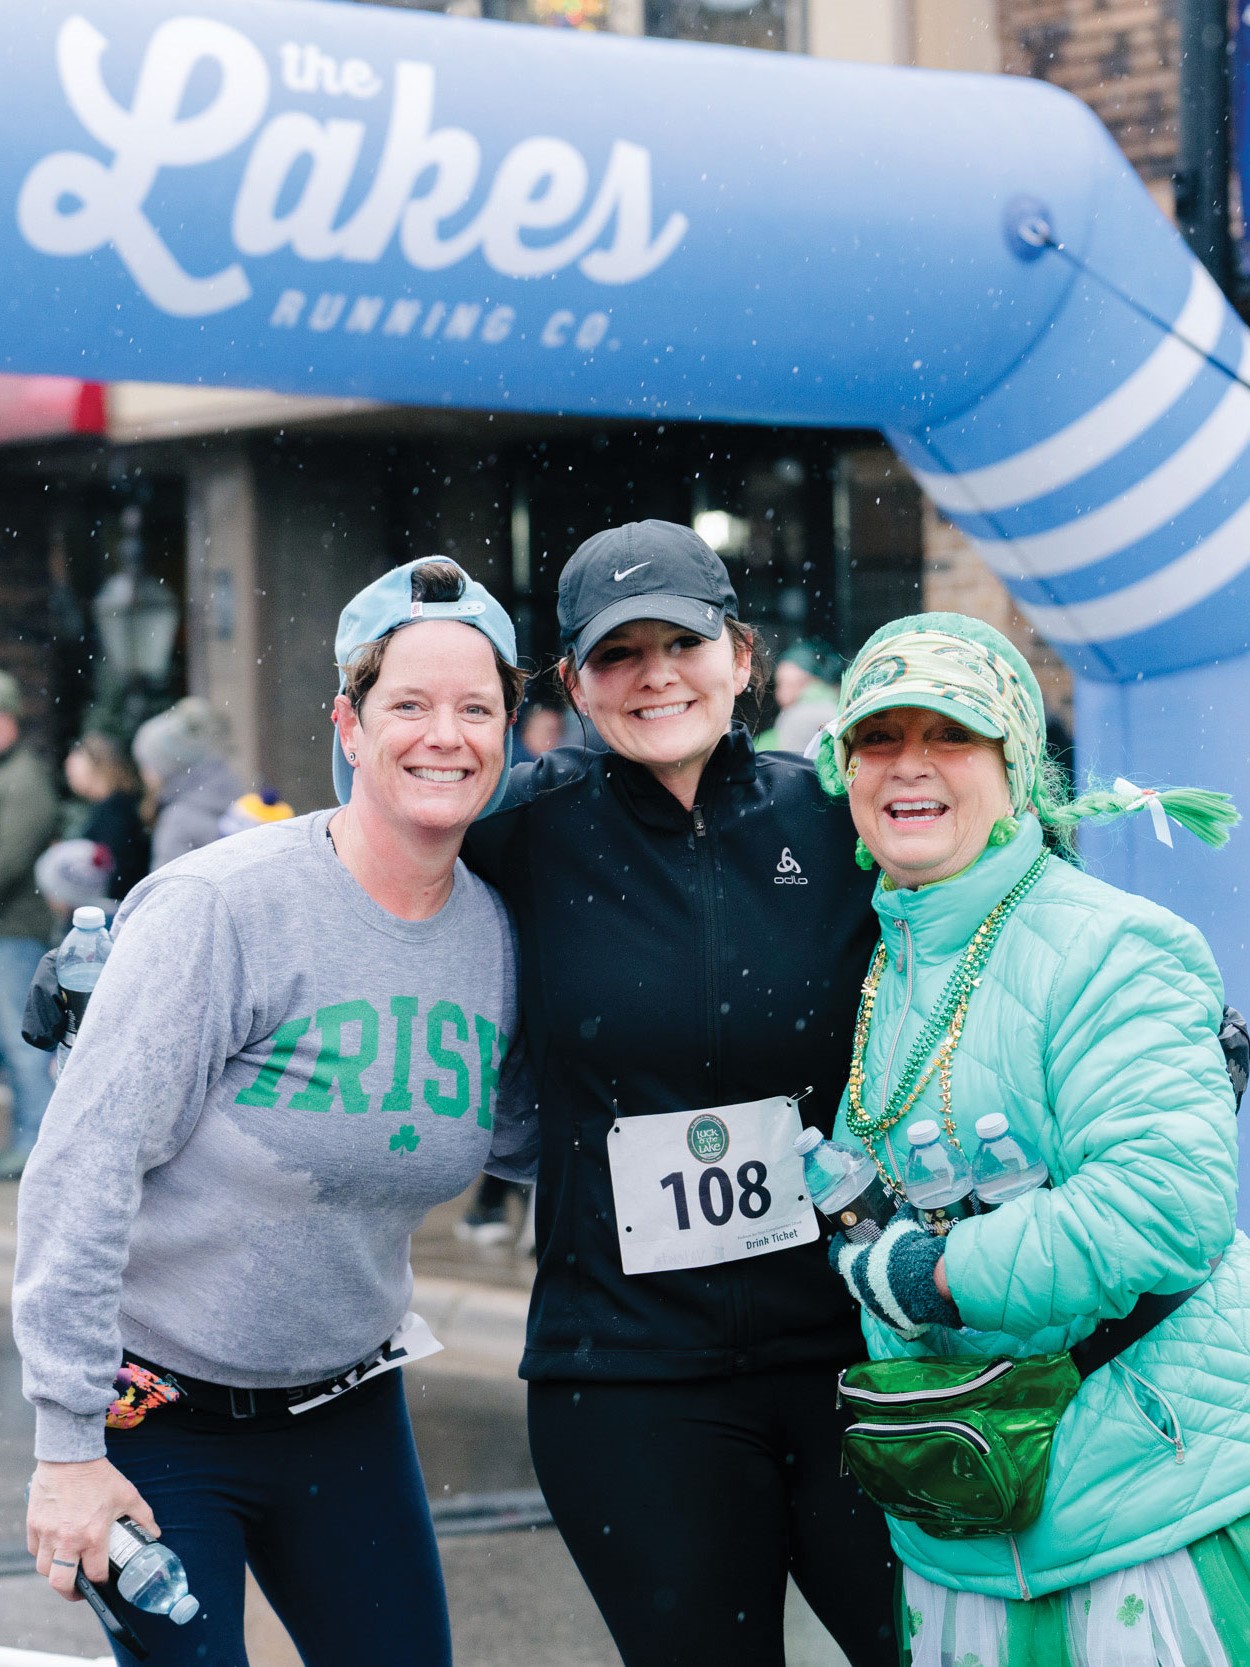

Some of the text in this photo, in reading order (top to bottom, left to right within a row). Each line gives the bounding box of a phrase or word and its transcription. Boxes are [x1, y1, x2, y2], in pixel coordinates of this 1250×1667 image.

[282, 42, 382, 98] the
[16, 14, 689, 319] Lakes
[270, 290, 621, 352] RUNNING CO.
[773, 875, 809, 885] odlo
[660, 1160, 772, 1231] 108
[745, 1236, 769, 1250] Drink
[771, 1228, 799, 1244] Ticket
